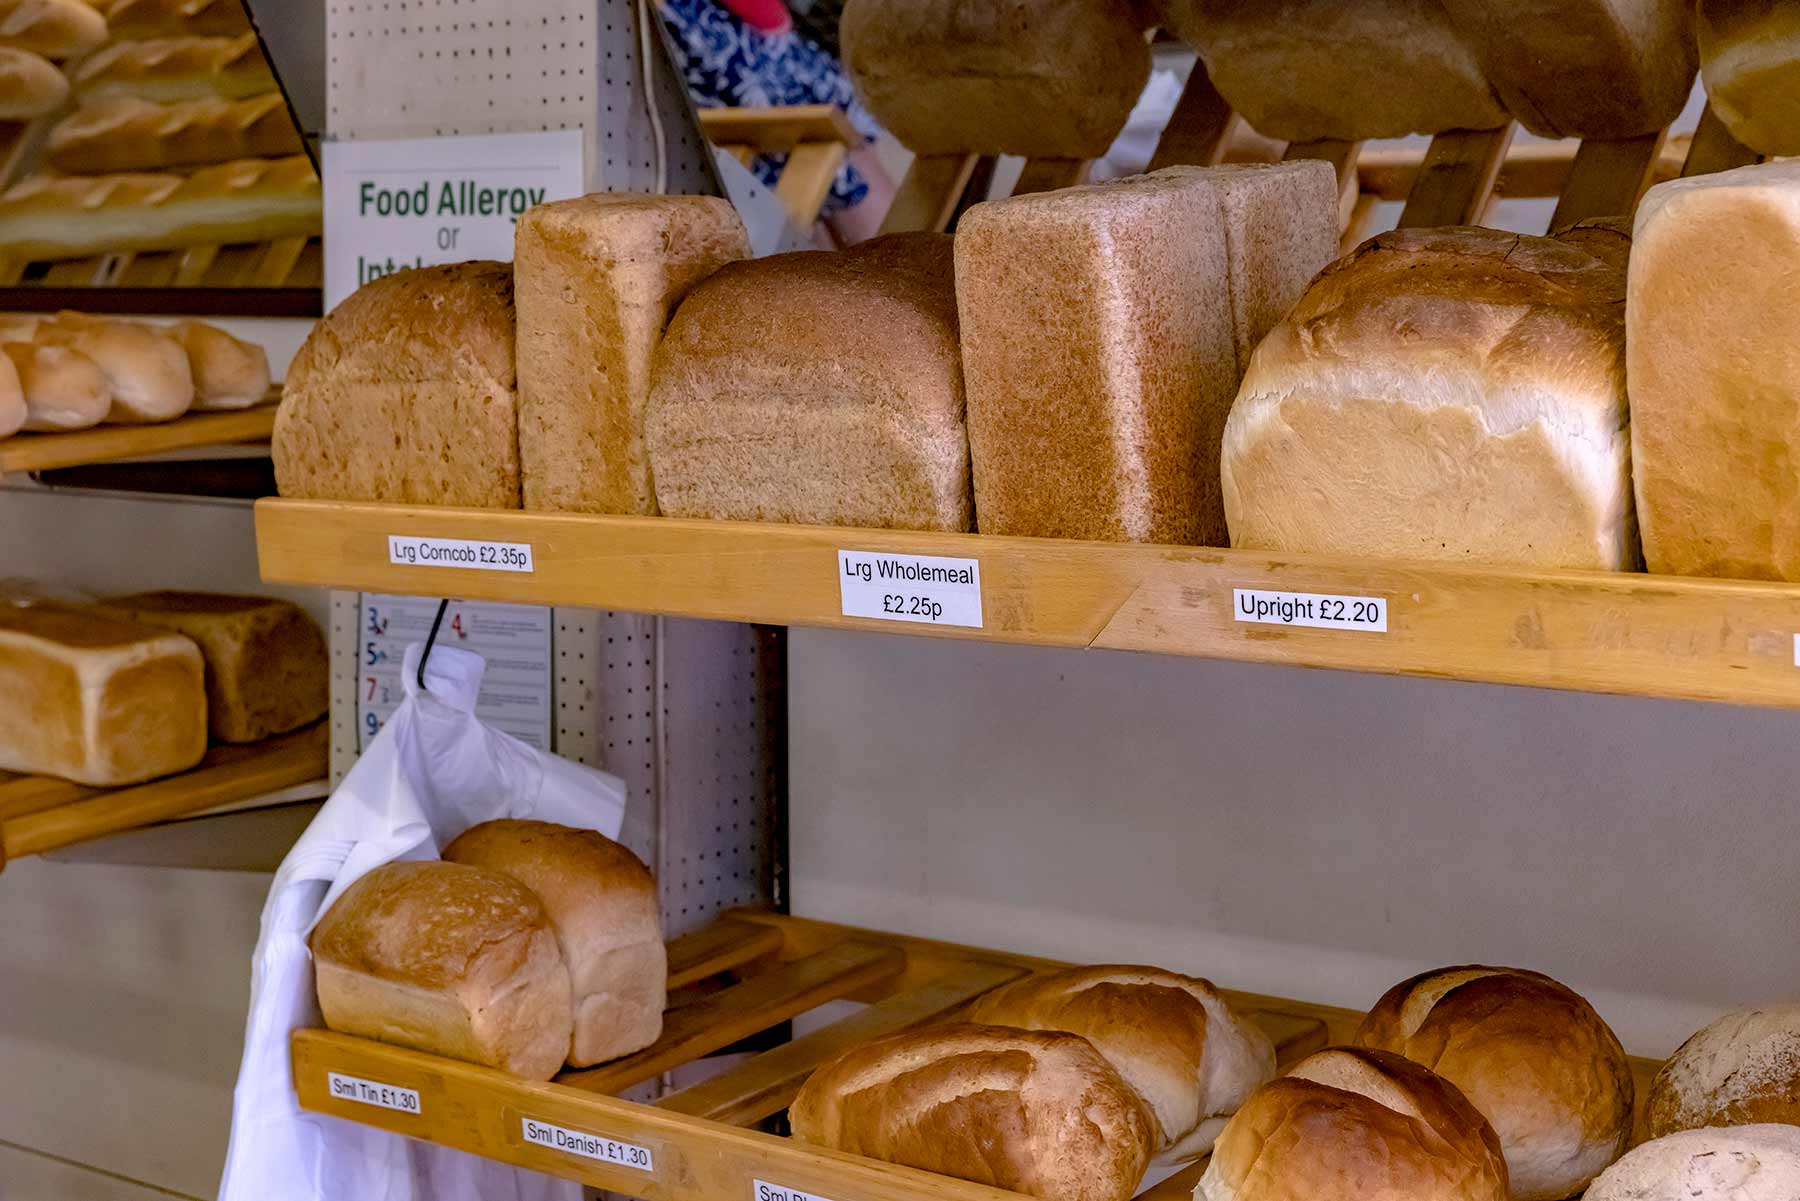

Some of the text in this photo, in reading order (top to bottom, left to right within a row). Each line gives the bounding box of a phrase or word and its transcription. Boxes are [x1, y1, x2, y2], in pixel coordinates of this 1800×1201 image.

[360, 180, 546, 224] Food Allergy
[437, 226, 461, 250] or
[394, 541, 527, 569] Lrg Corncob £2.35p
[845, 557, 974, 585] Lrg Wholemeal
[883, 594, 943, 621] £2.25p
[1240, 593, 1379, 624] Upright £2.20
[366, 642, 378, 666] 5
[366, 677, 377, 702] 7
[366, 712, 378, 736] 9
[333, 1077, 416, 1110] Sml Tin £1.30
[527, 1122, 648, 1166] Sml Danish £1.30
